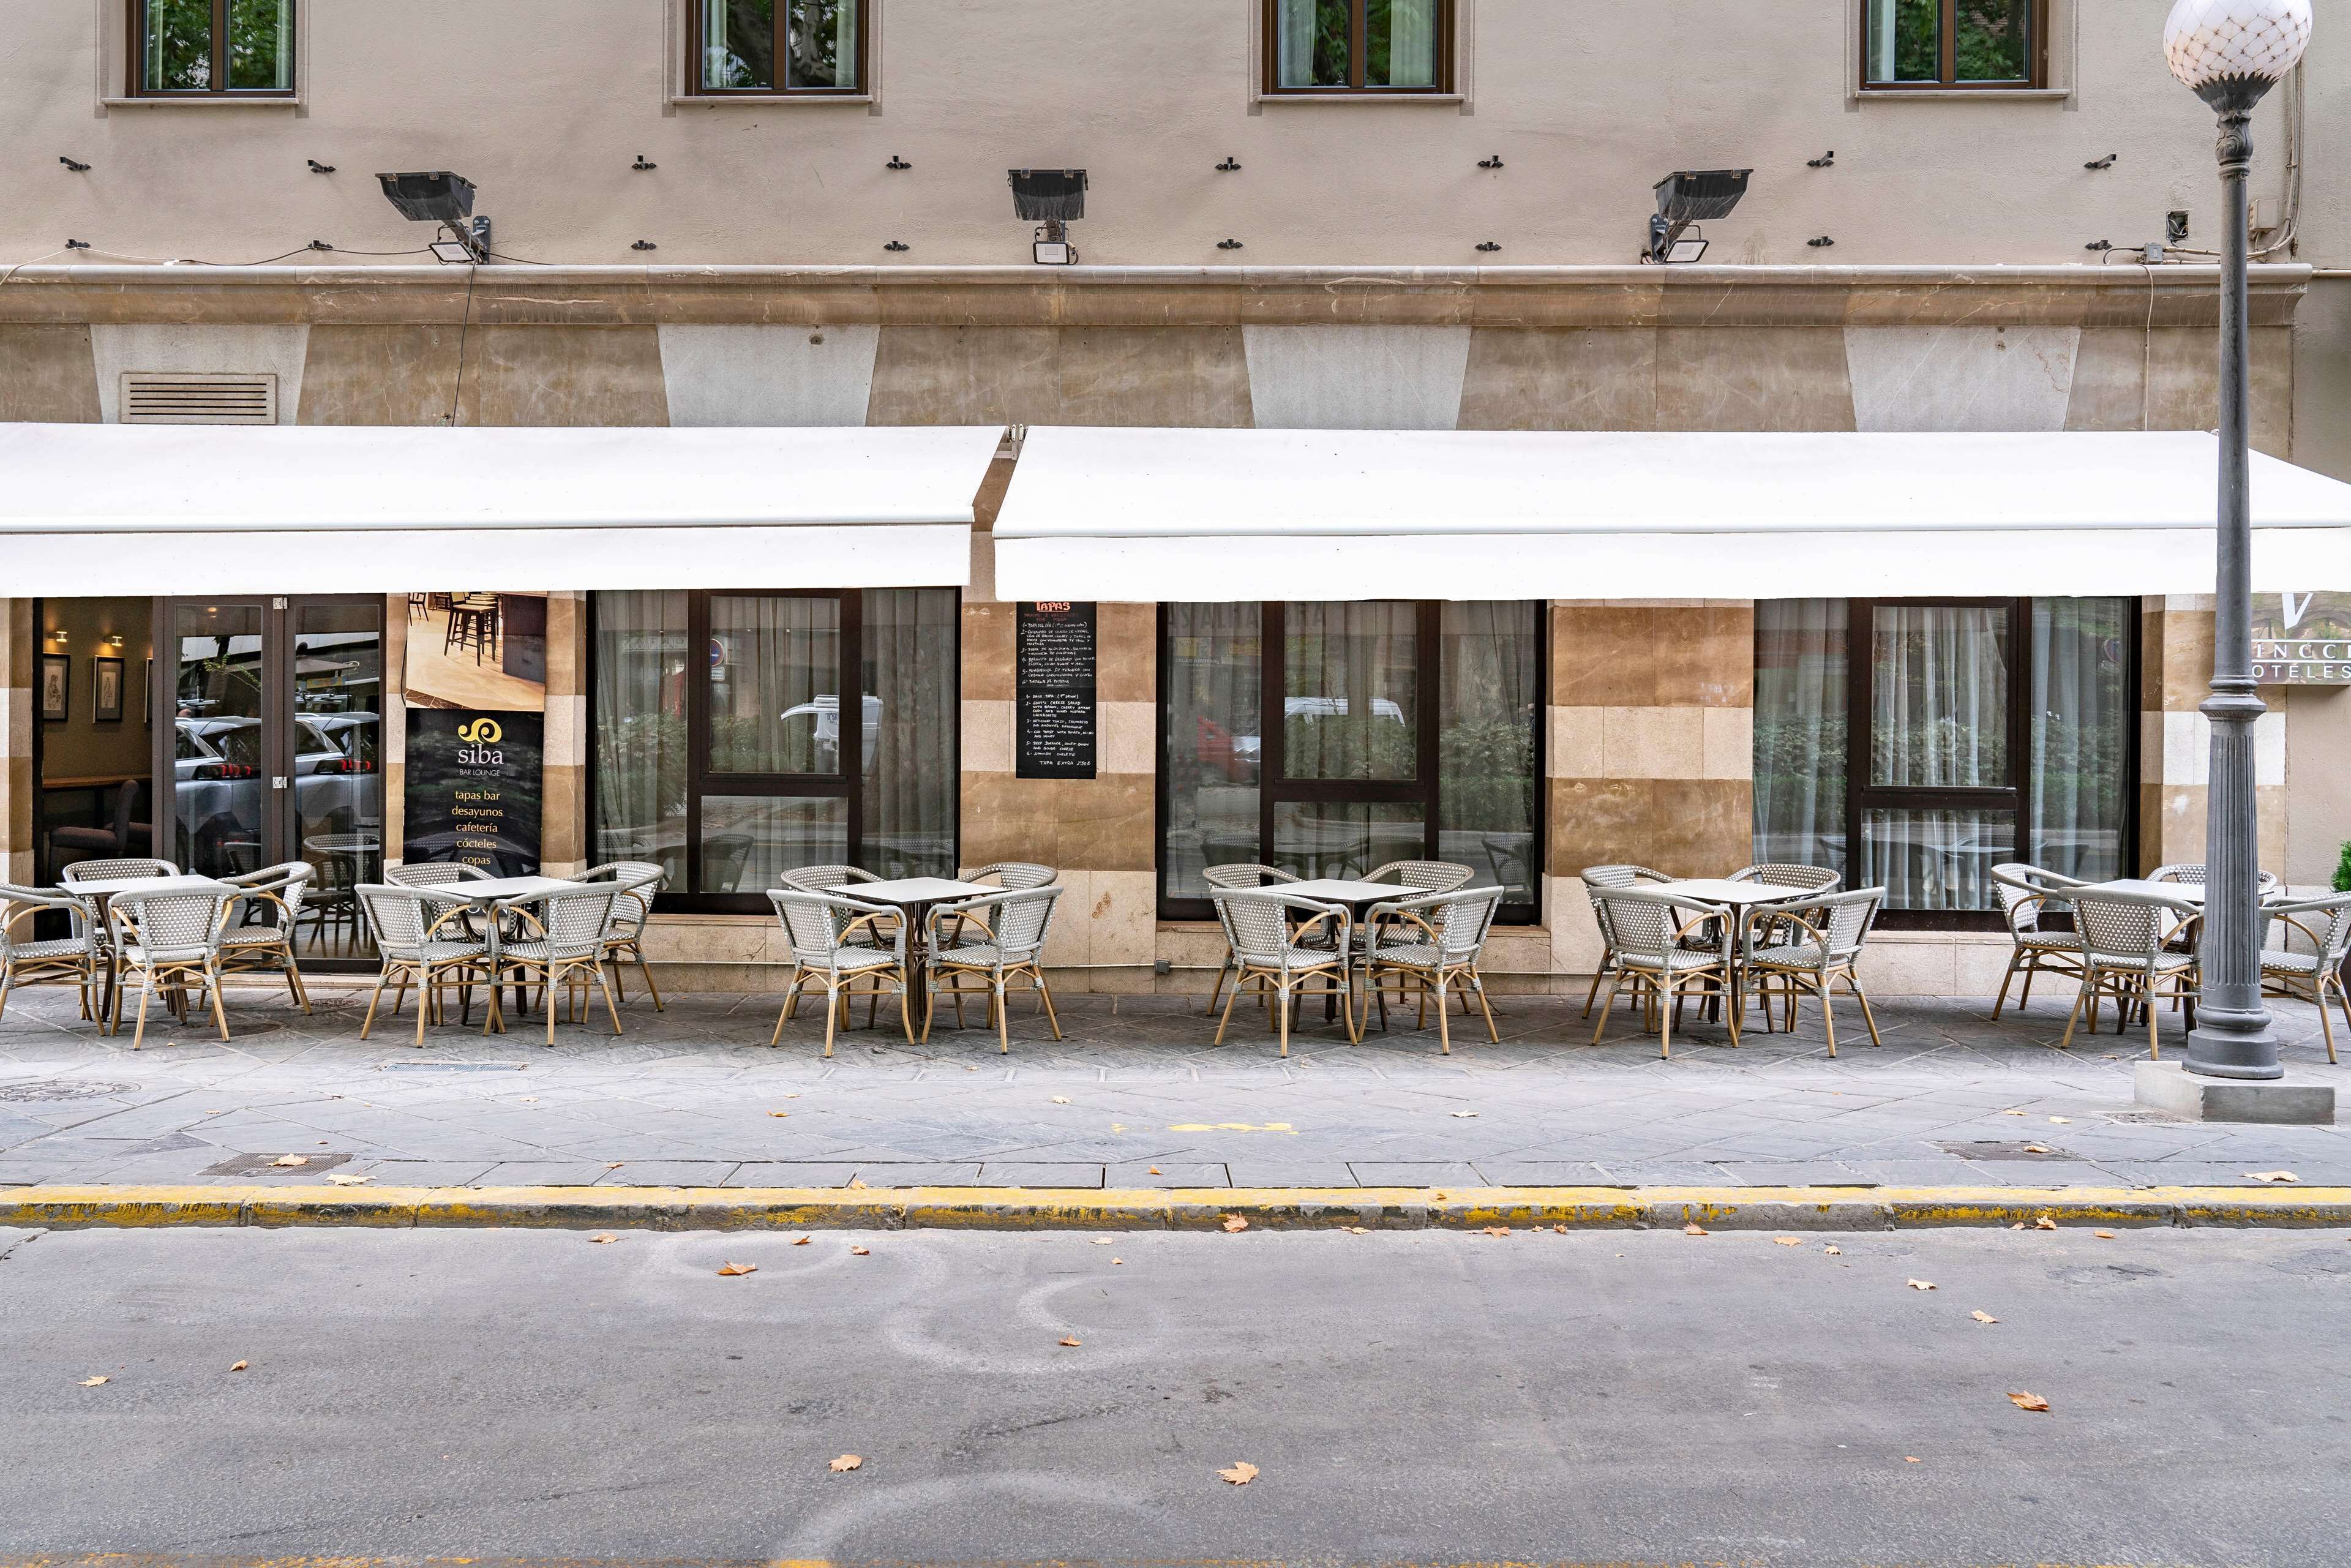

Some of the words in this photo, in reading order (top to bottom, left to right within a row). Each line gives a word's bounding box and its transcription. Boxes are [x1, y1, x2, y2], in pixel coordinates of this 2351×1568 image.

[1037, 602, 1071, 612] TAPAS
[2257, 644, 2351, 659] INCCI
[2251, 664, 2351, 678] OTELES
[457, 743, 504, 765] siba
[456, 790, 481, 802] tapas
[484, 790, 500, 800] bar
[452, 806, 503, 819] desayunos
[456, 822, 498, 833] cafetería
[456, 838, 497, 849] cócteles
[462, 856, 491, 866] copas
